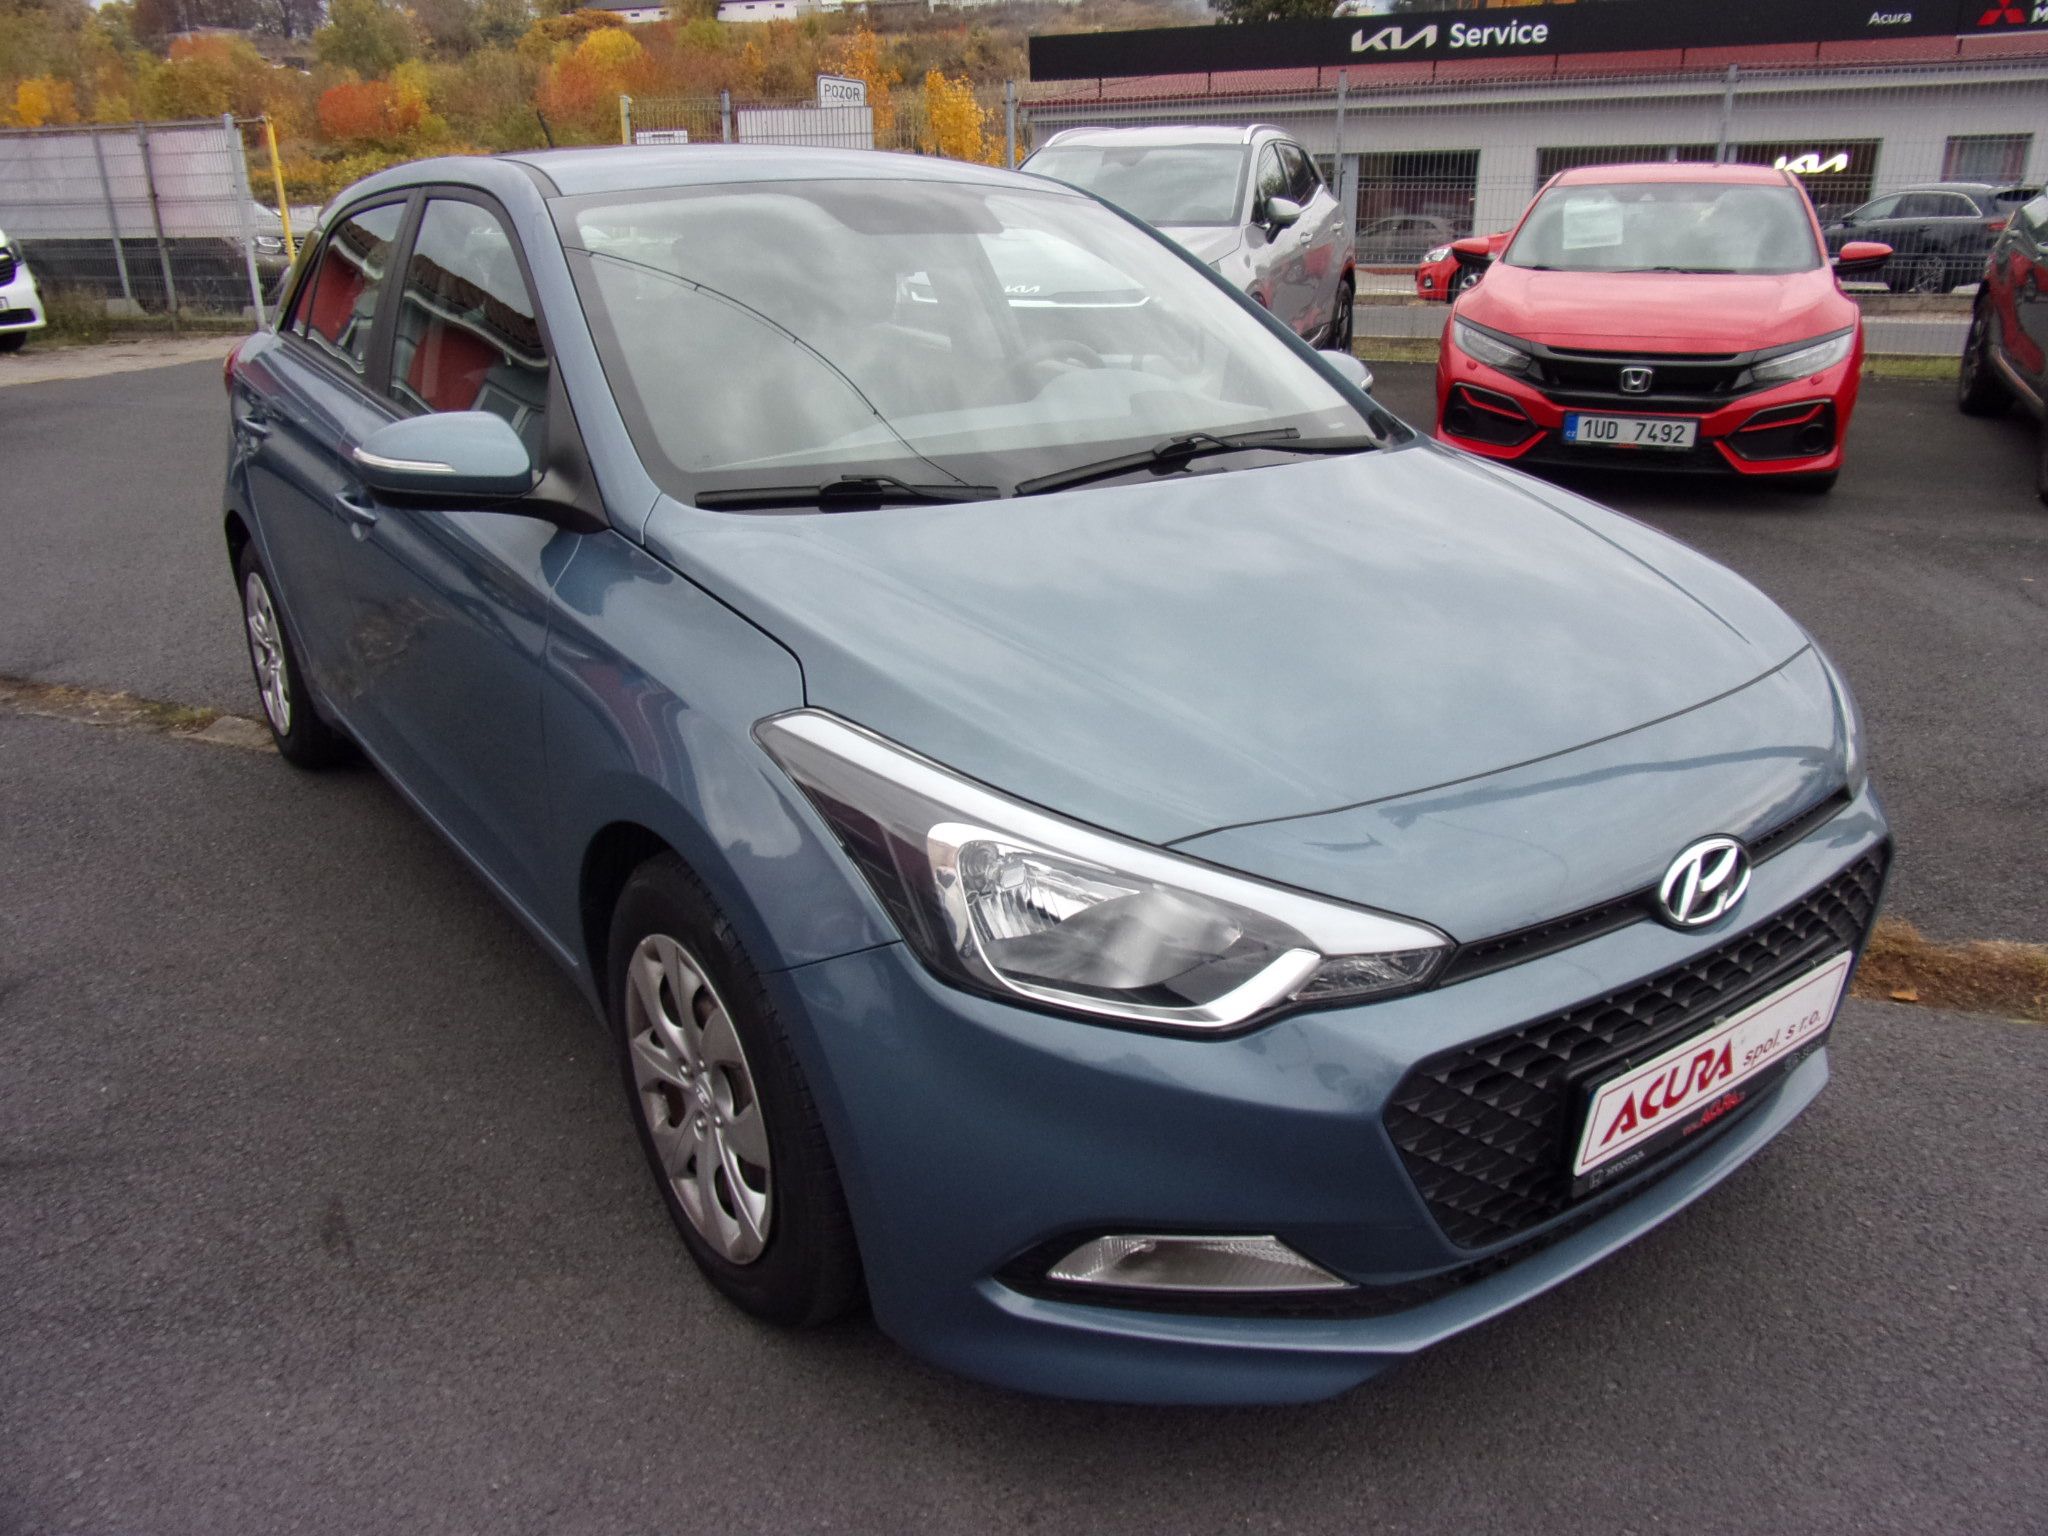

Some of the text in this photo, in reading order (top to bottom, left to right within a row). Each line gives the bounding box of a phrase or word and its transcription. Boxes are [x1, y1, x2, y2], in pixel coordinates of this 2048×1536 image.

[1867, 11, 1913, 26] Acura
[1351, 19, 1549, 52] KIA Service
[824, 83, 860, 101] POZOR
[1774, 153, 1848, 173] KIA
[1583, 419, 1686, 444] 1UD 7492
[1600, 1038, 1733, 1146] ACURA
[1743, 1028, 1780, 1068] spol.
[1785, 1023, 1796, 1040] s
[1799, 1010, 1821, 1033] r.o.
